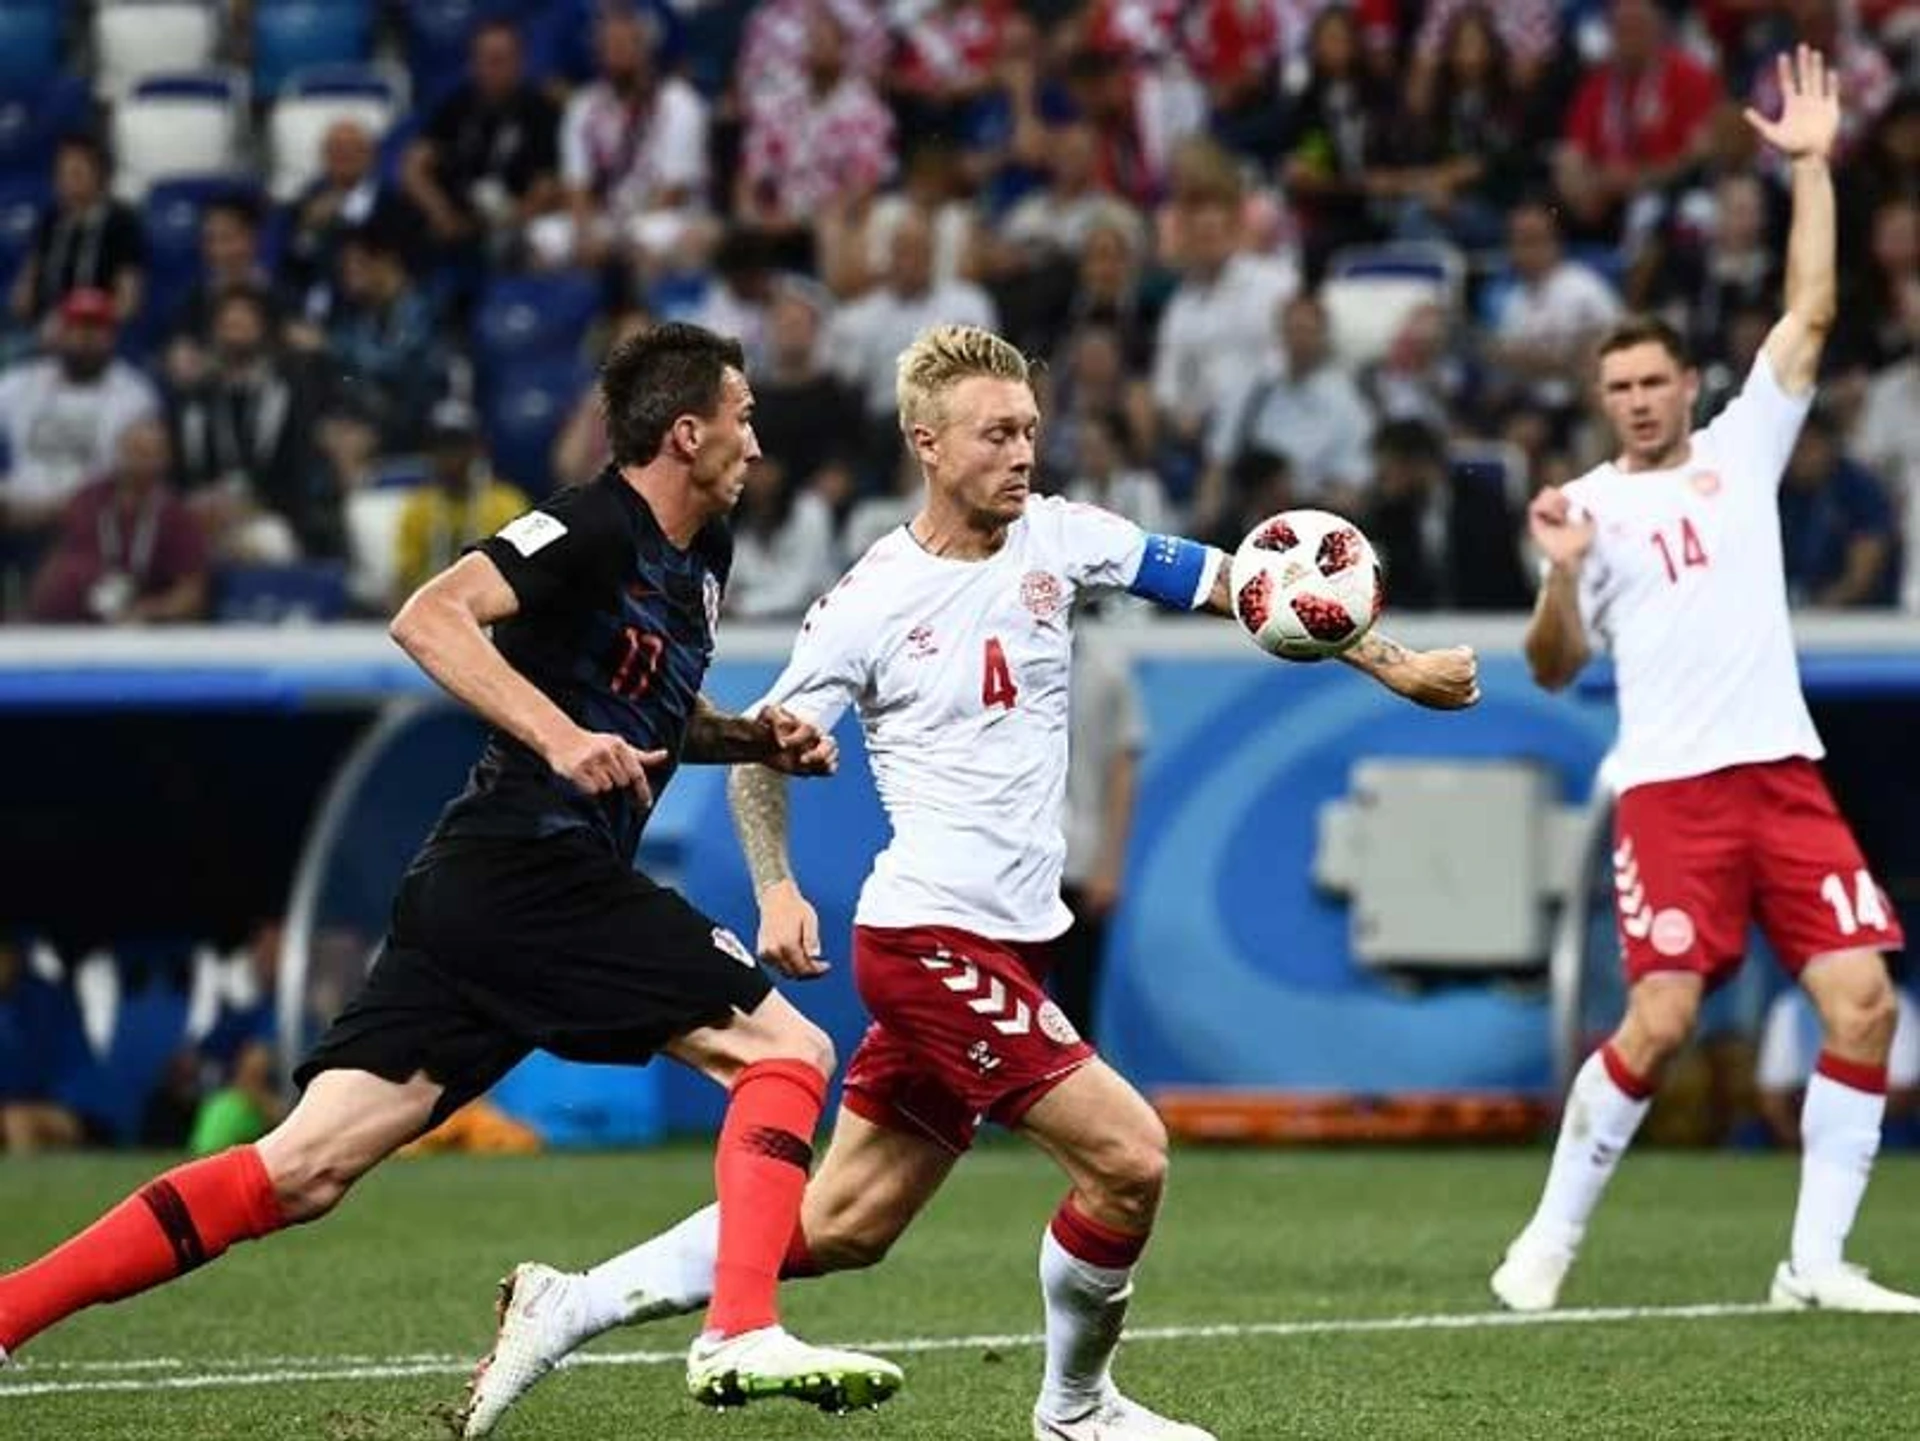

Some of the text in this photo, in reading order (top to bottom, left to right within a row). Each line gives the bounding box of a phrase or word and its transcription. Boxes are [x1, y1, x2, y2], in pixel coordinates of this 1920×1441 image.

[1651, 516, 1708, 583] 14
[610, 627, 663, 700] 17
[982, 636, 1018, 710] 4
[1820, 867, 1891, 936] 14
